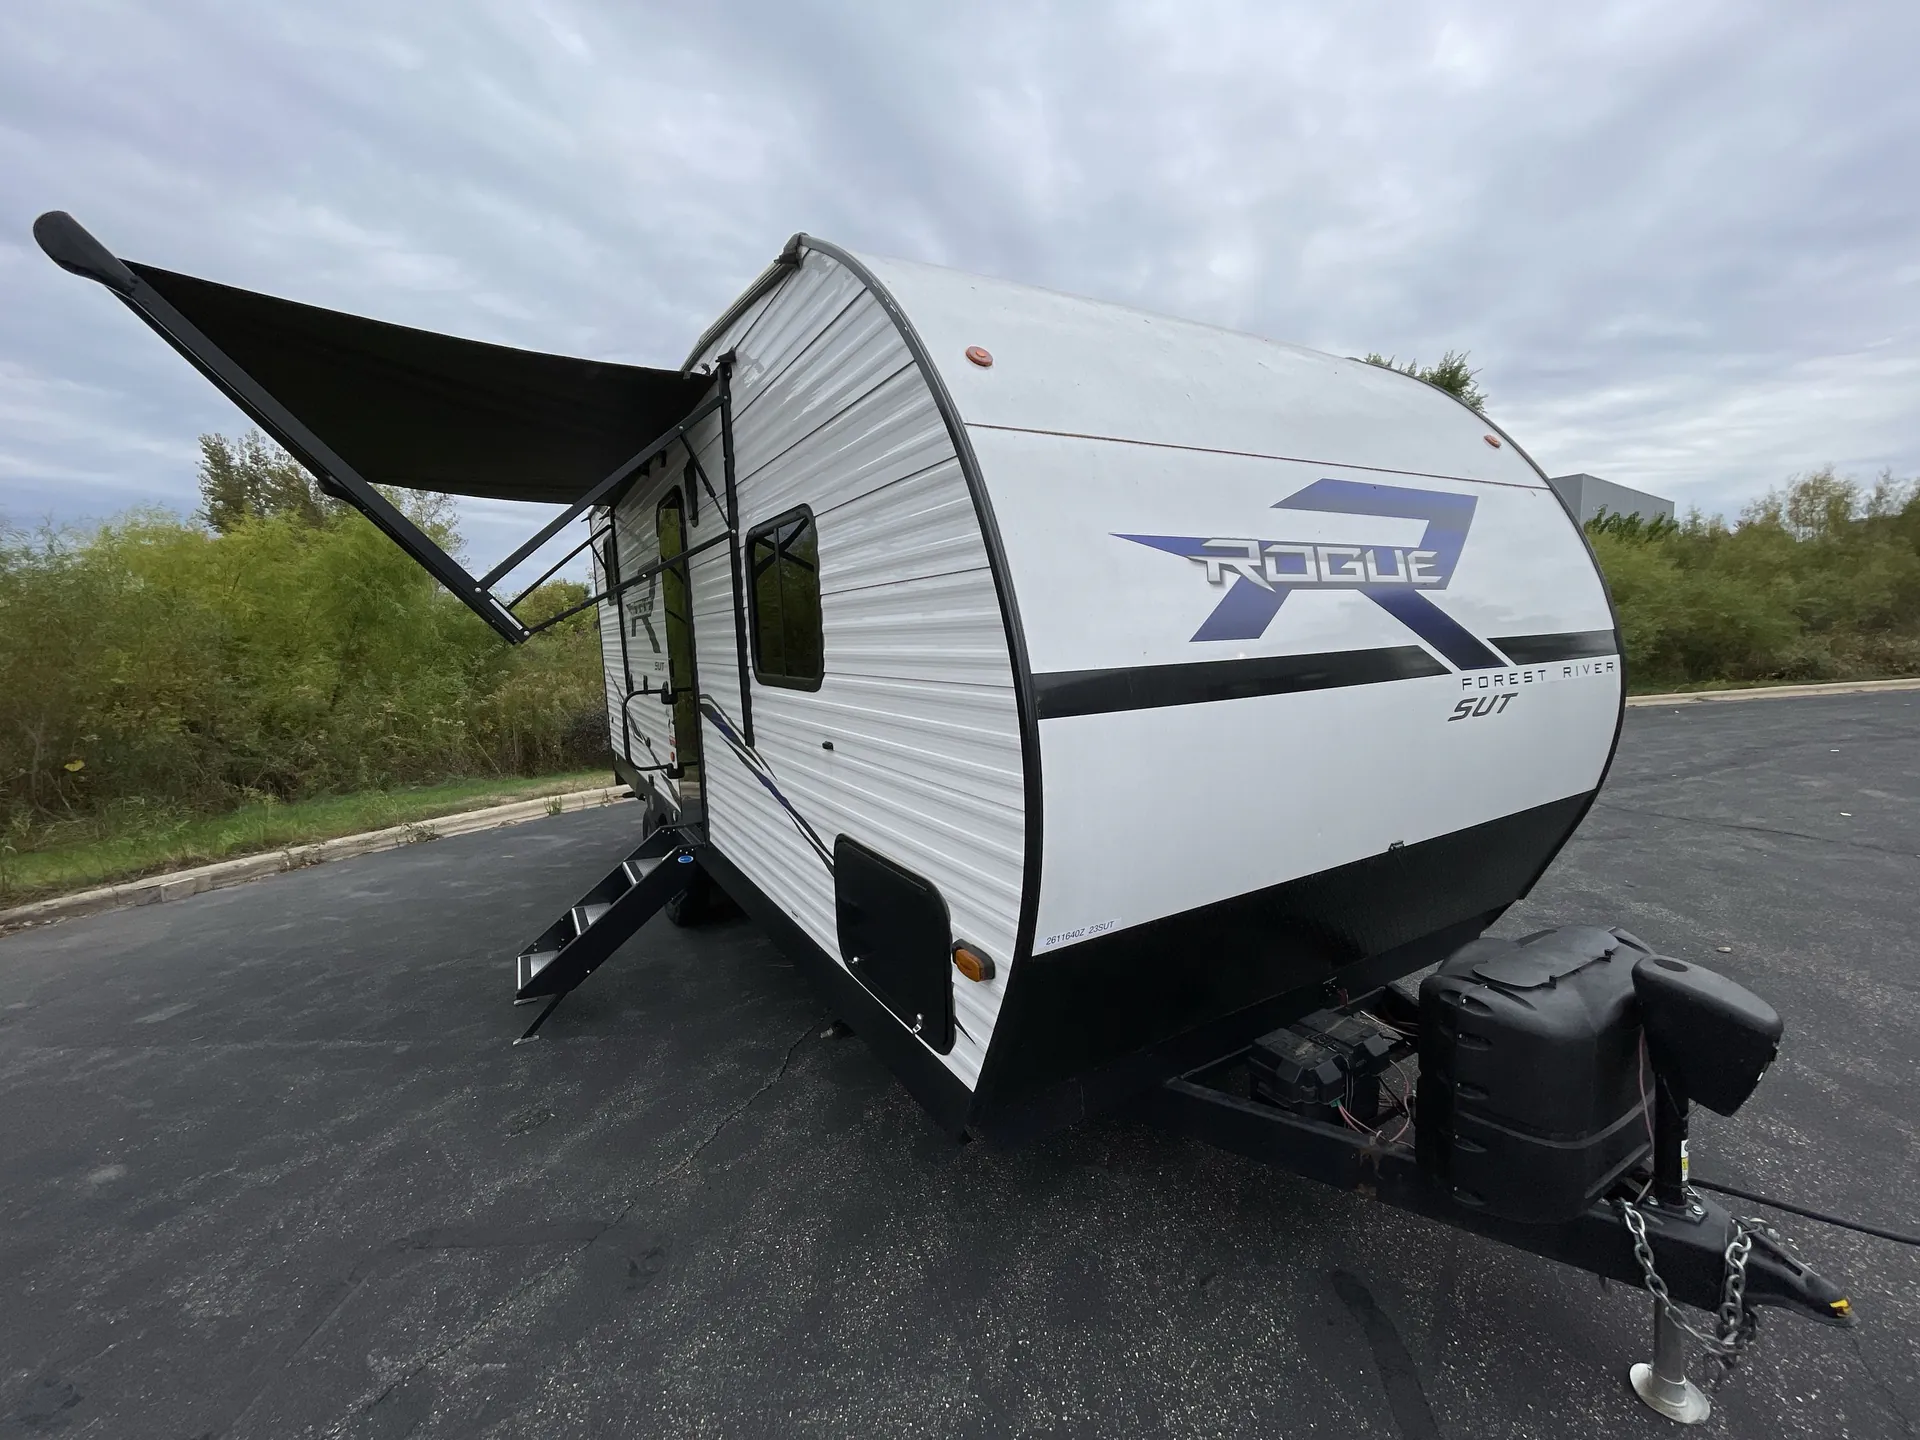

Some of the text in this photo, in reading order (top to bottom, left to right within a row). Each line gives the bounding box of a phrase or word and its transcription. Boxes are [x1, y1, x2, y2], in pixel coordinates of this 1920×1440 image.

[1188, 538, 1443, 593] ROGUE
[1462, 661, 1614, 691] FOREST RIVER
[1447, 692, 1519, 722] SUT
[1088, 921, 1114, 934] 23SUT
